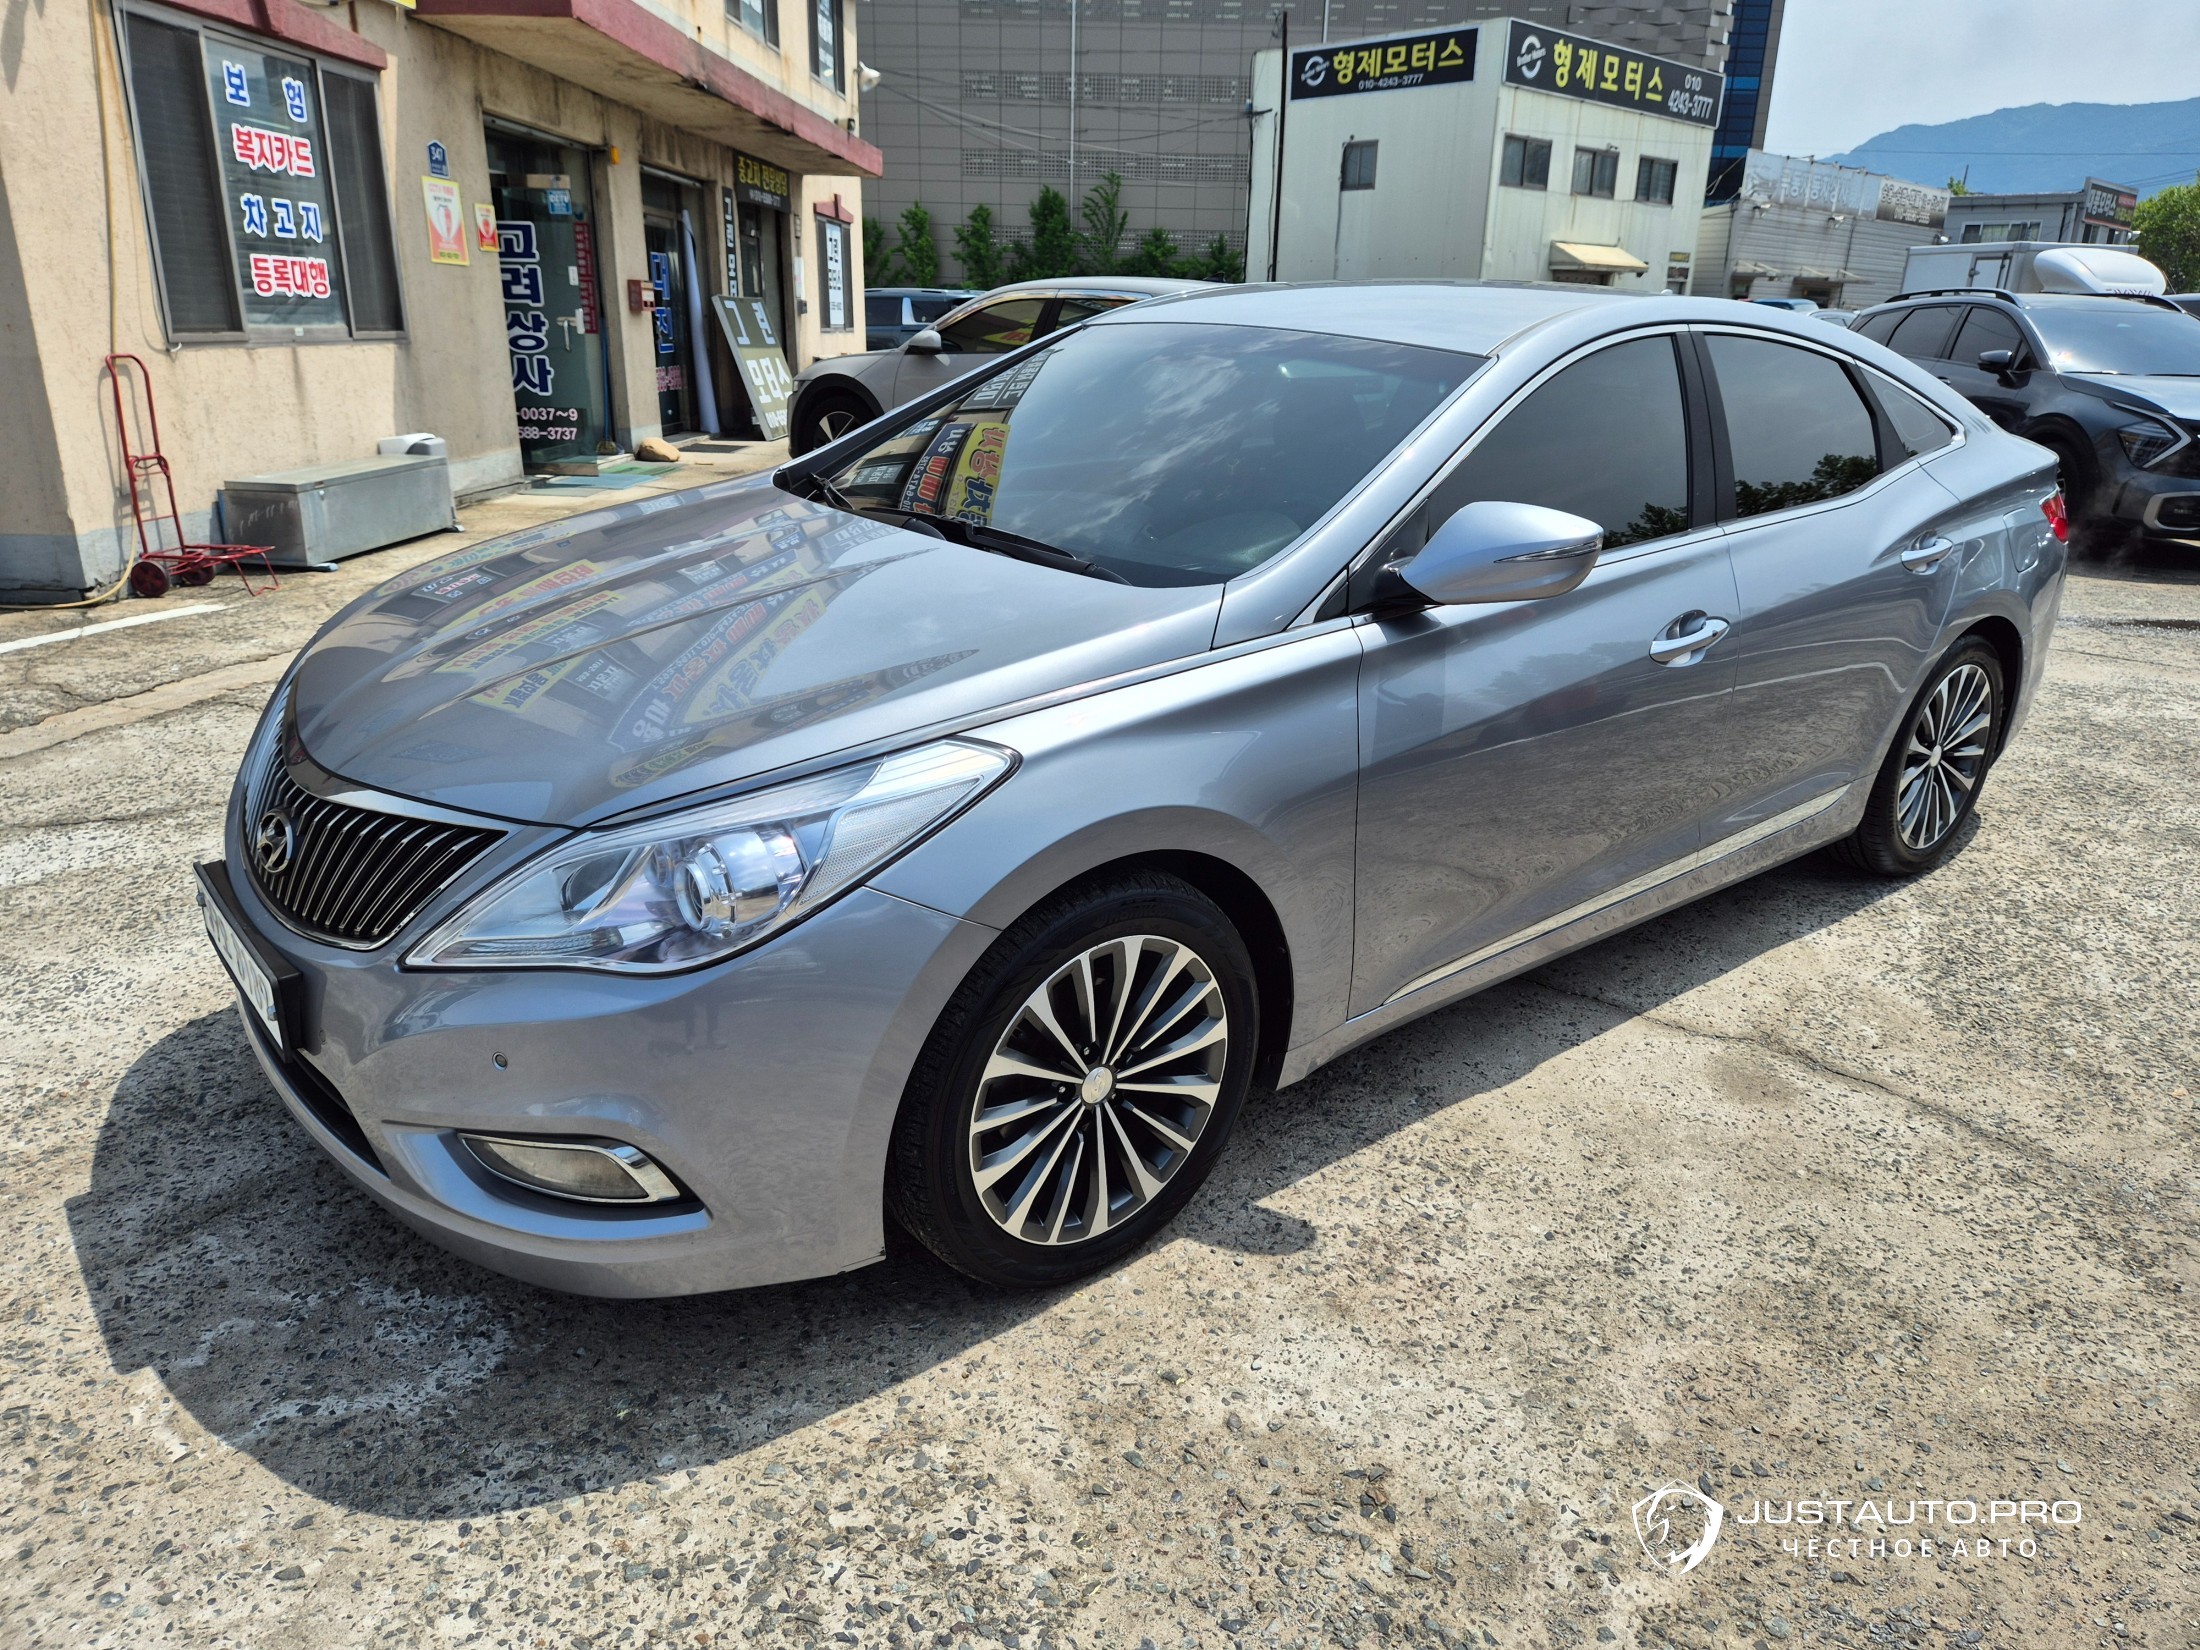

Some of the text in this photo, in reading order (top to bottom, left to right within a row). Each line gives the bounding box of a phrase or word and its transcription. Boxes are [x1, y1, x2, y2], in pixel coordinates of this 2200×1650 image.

[1332, 38, 1464, 84] 형제모터스
[1358, 73, 1424, 90] 010-4243-3777
[1553, 38, 1663, 102] 형제모터스
[1684, 74, 1702, 91] 010
[1667, 89, 1713, 119] 4243-3777
[231, 123, 316, 178] 복지카드
[250, 253, 331, 298] 등록대행
[496, 221, 555, 397] 고려상사
